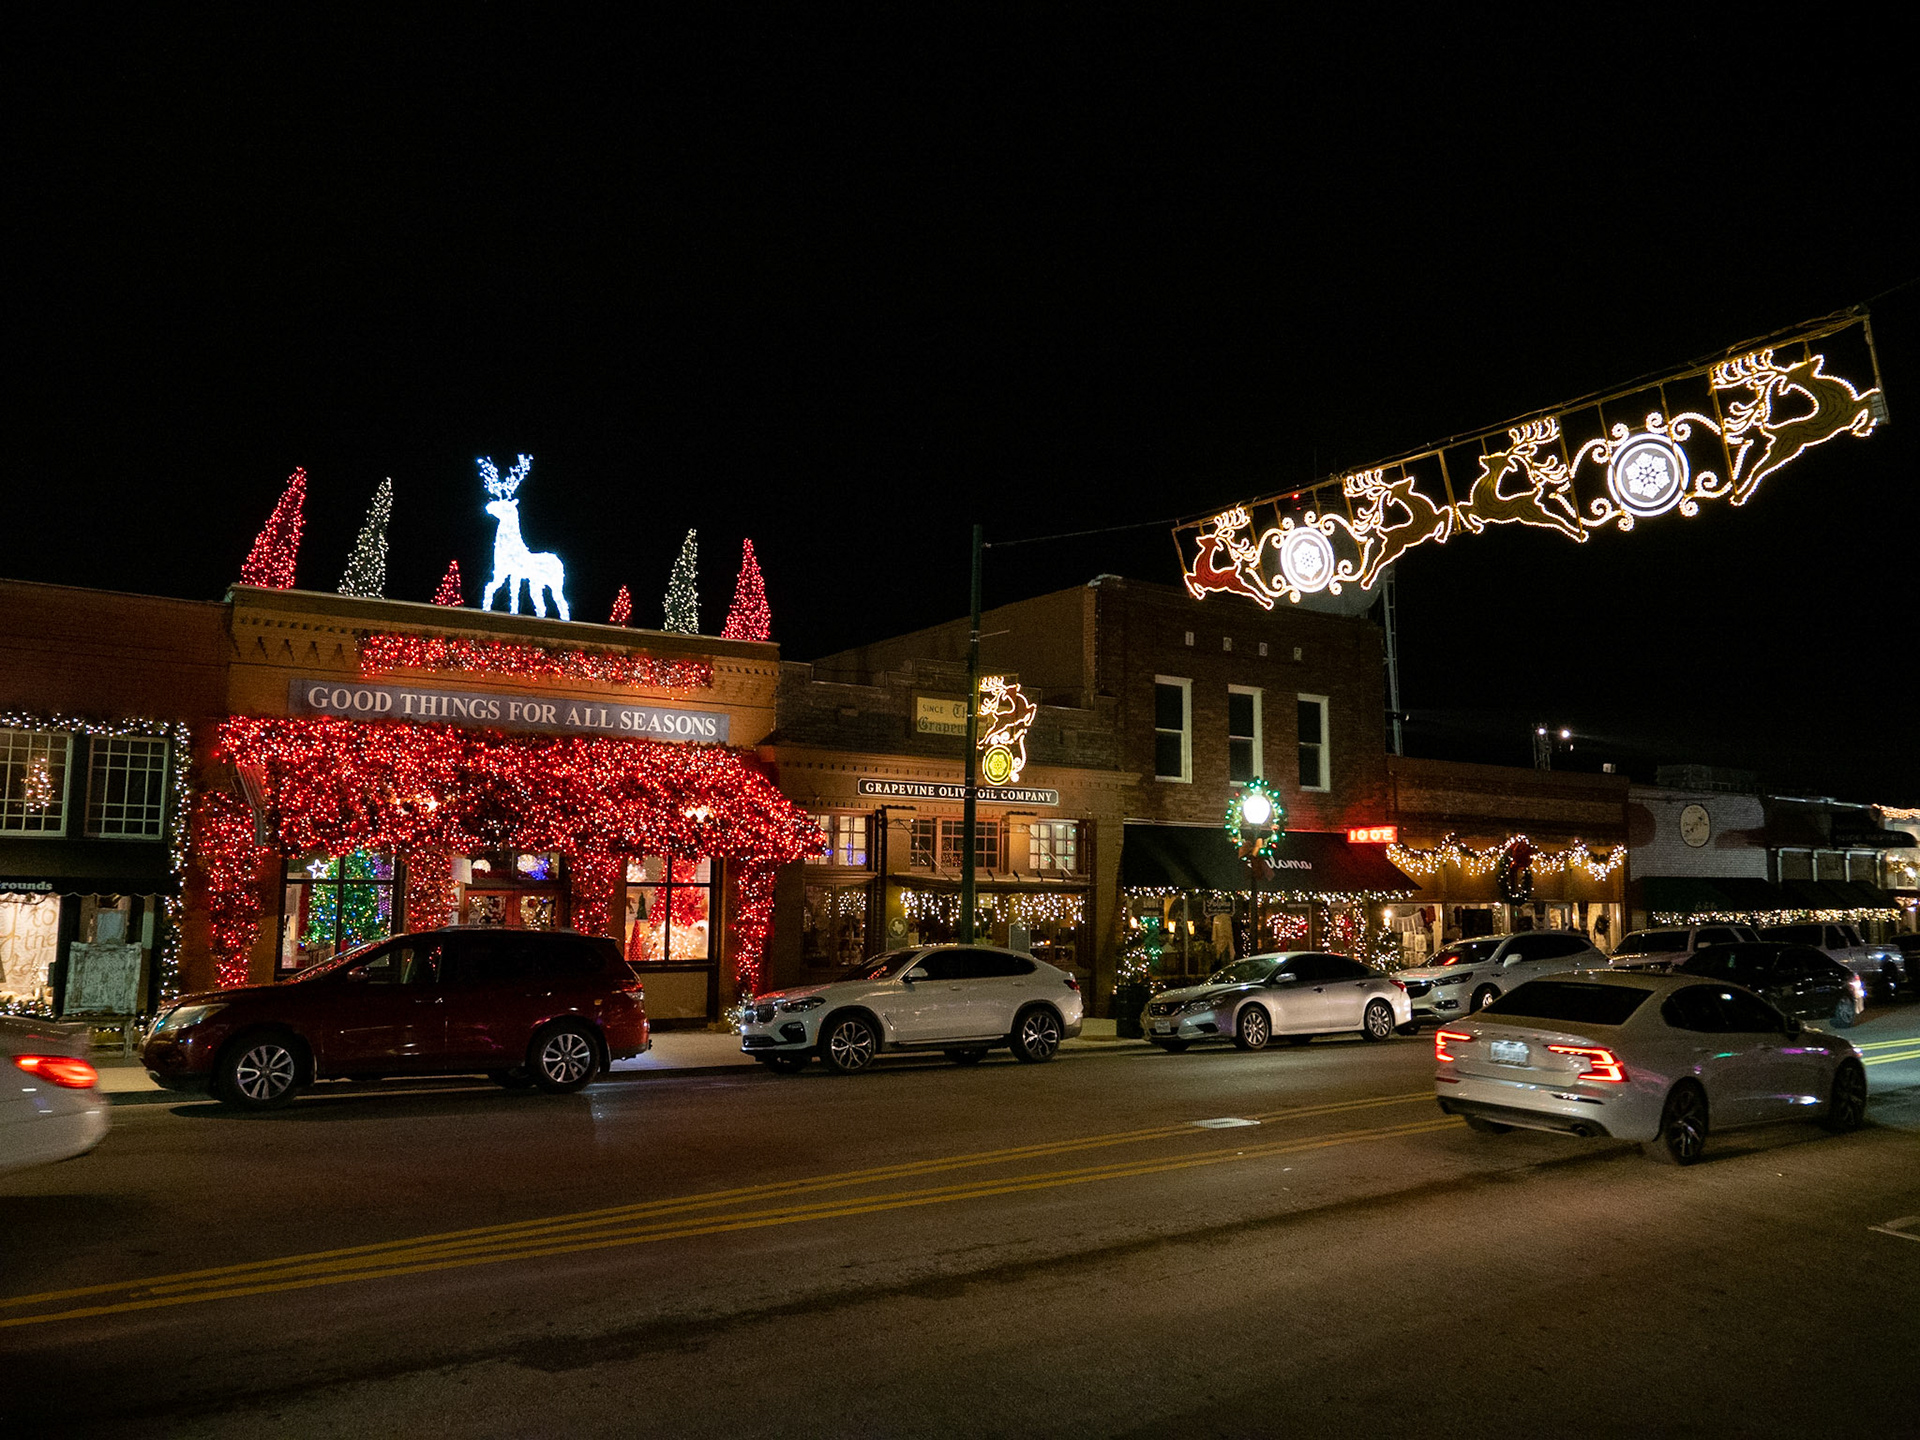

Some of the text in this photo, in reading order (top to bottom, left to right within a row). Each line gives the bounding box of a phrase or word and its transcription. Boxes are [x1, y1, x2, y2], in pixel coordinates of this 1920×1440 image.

[308, 686, 717, 737] GOOD THINGS FOR ALL SEASONS
[922, 703, 968, 719] SINCE Th
[865, 782, 1052, 802] GRAPEVINE OLIV OIL COMPANY
[0, 881, 53, 891] rounds
[24, 929, 57, 951] the
